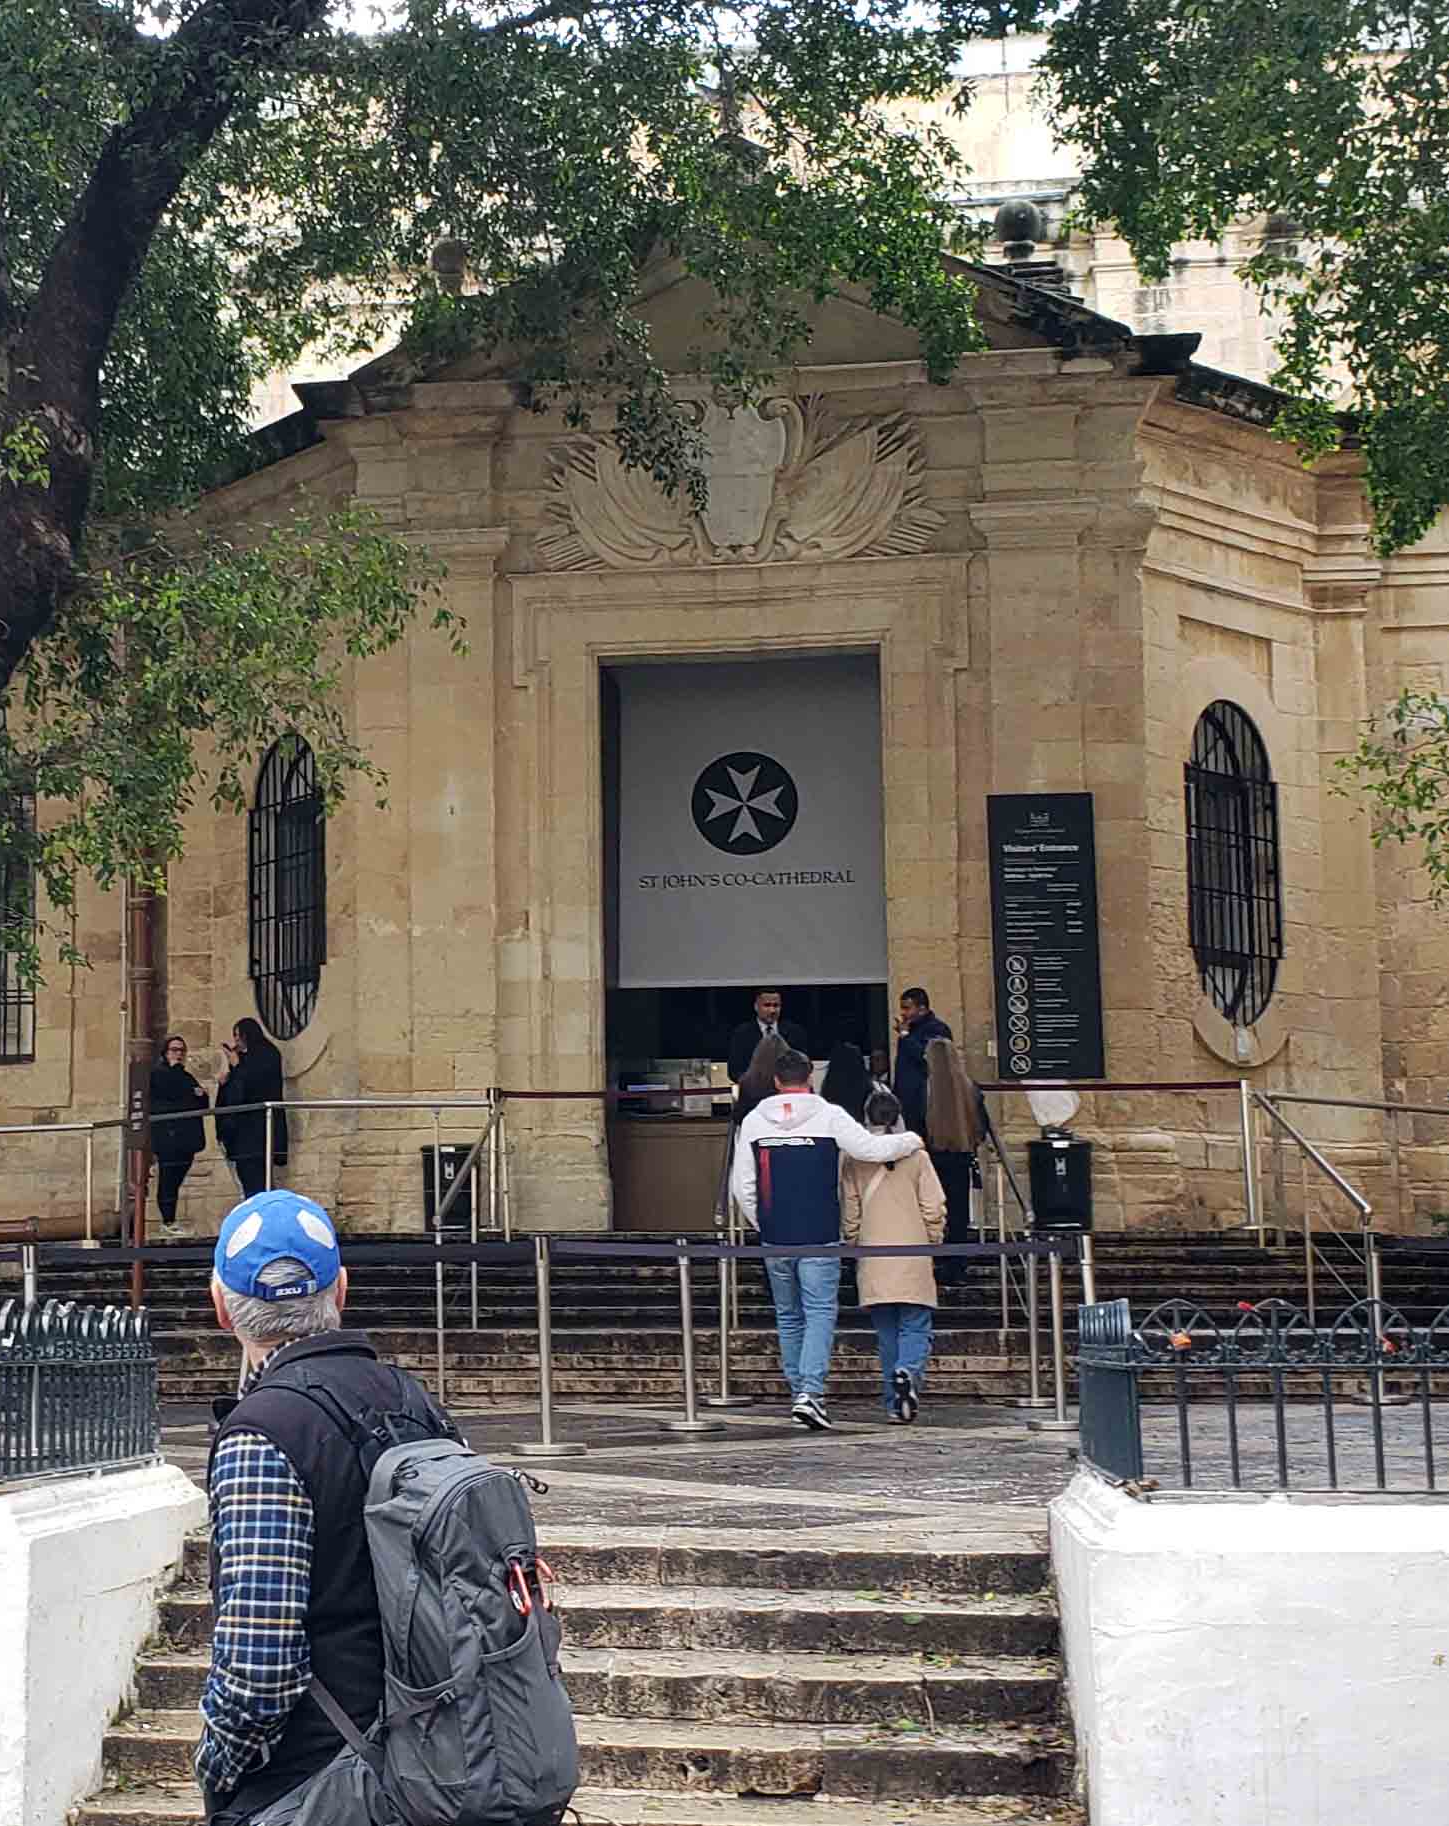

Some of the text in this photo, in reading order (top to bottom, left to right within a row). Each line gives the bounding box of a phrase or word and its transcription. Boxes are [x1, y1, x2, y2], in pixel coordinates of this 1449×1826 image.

[639, 870, 855, 889] ST JOHN'S CO-CATHEDRAL
